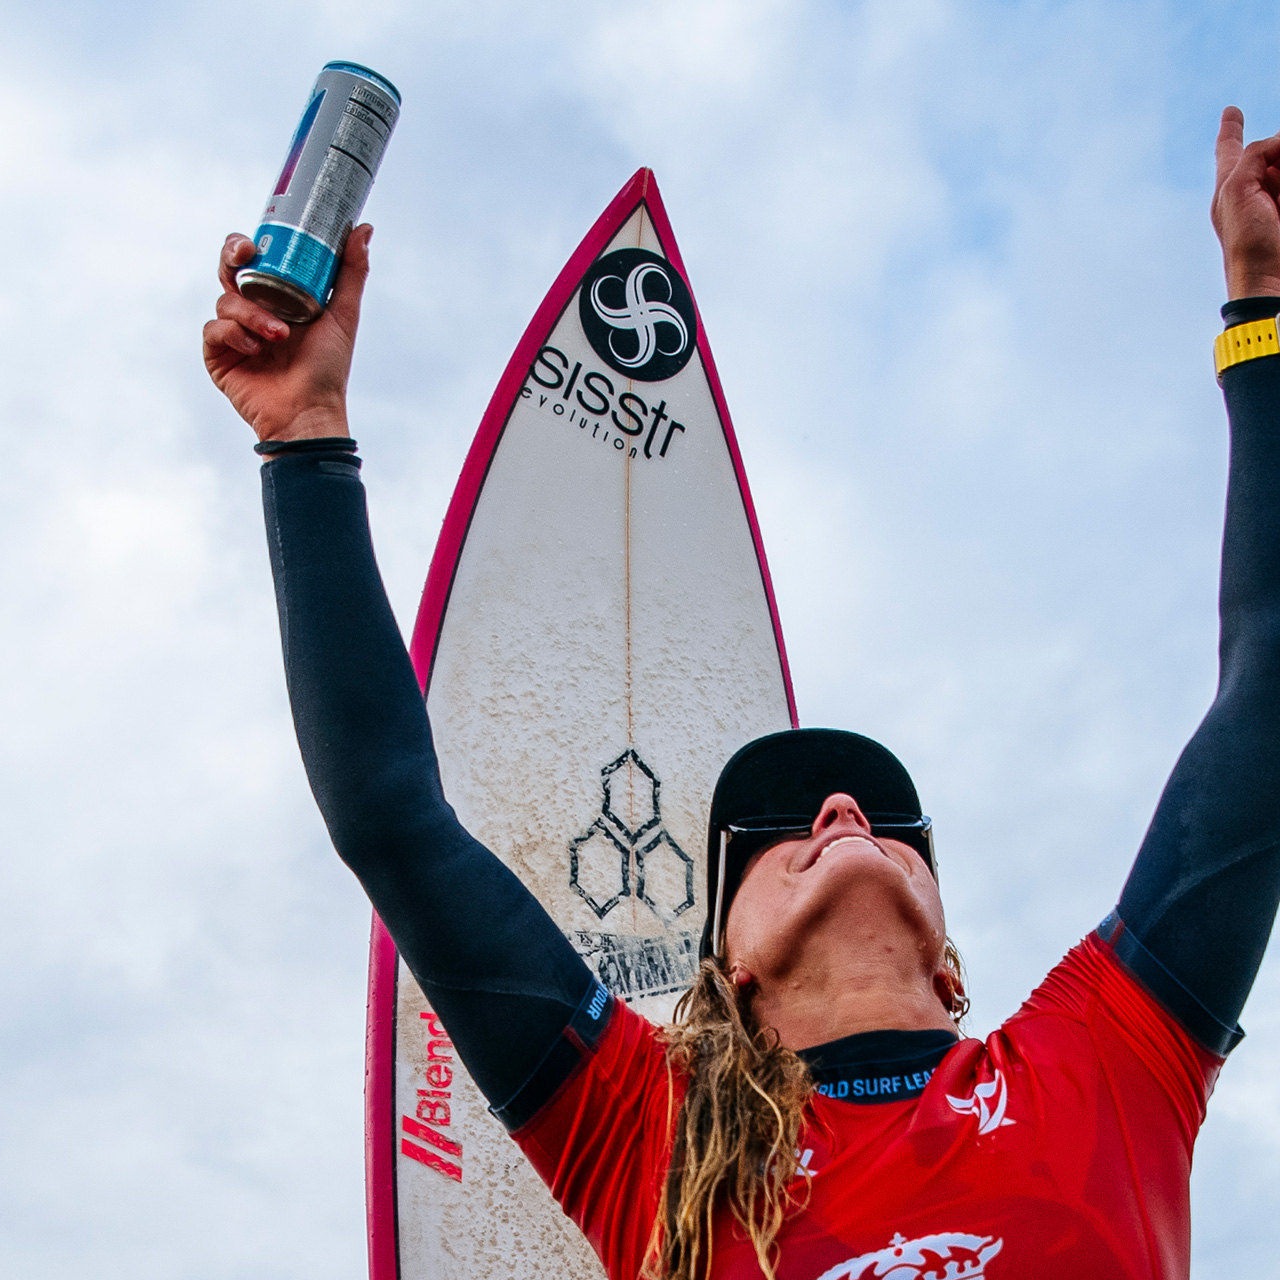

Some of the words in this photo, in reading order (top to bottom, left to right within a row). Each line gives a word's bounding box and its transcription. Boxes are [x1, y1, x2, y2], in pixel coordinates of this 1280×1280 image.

[520, 386, 638, 459] evolution
[416, 1012, 453, 1127] Blend
[852, 1077, 902, 1097] SURF
[903, 1067, 936, 1091] LEA
